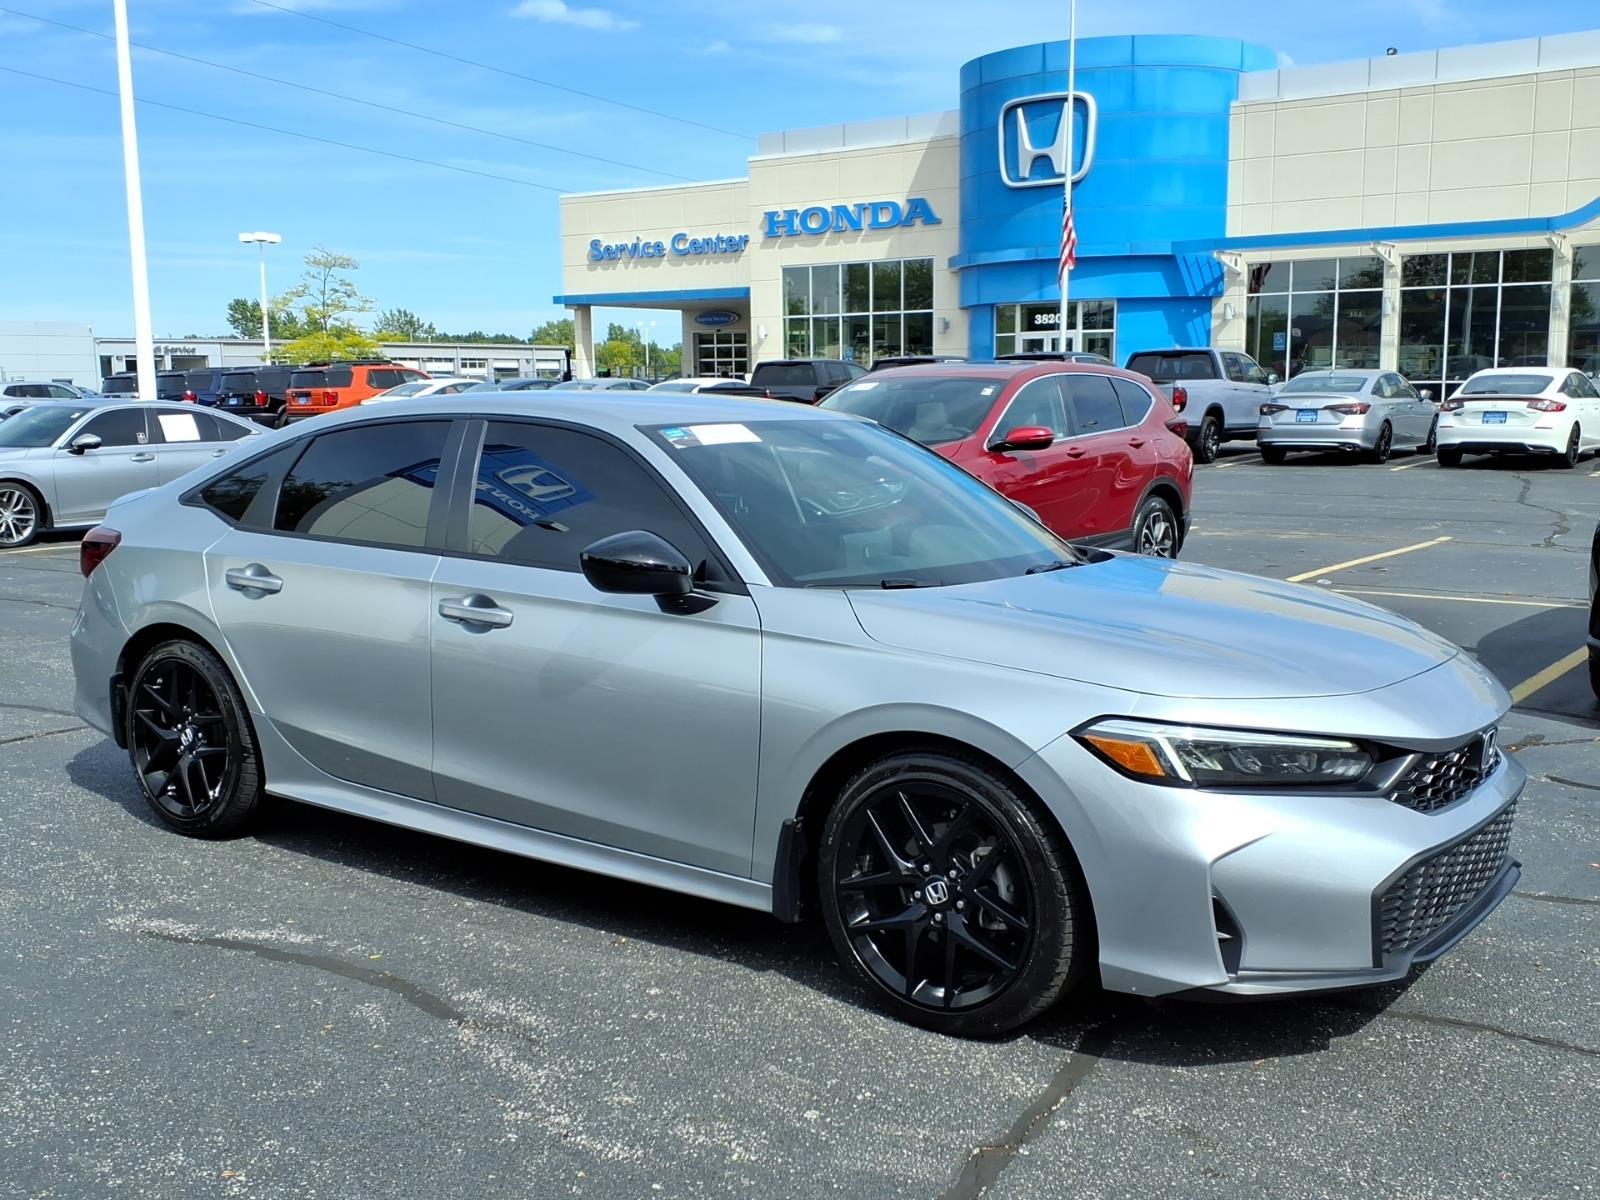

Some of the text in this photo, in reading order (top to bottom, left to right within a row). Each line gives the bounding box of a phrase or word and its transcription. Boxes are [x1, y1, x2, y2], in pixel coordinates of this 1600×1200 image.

[764, 197, 942, 239] HONDA
[589, 232, 750, 262] Service Center
[164, 345, 196, 356] Service
